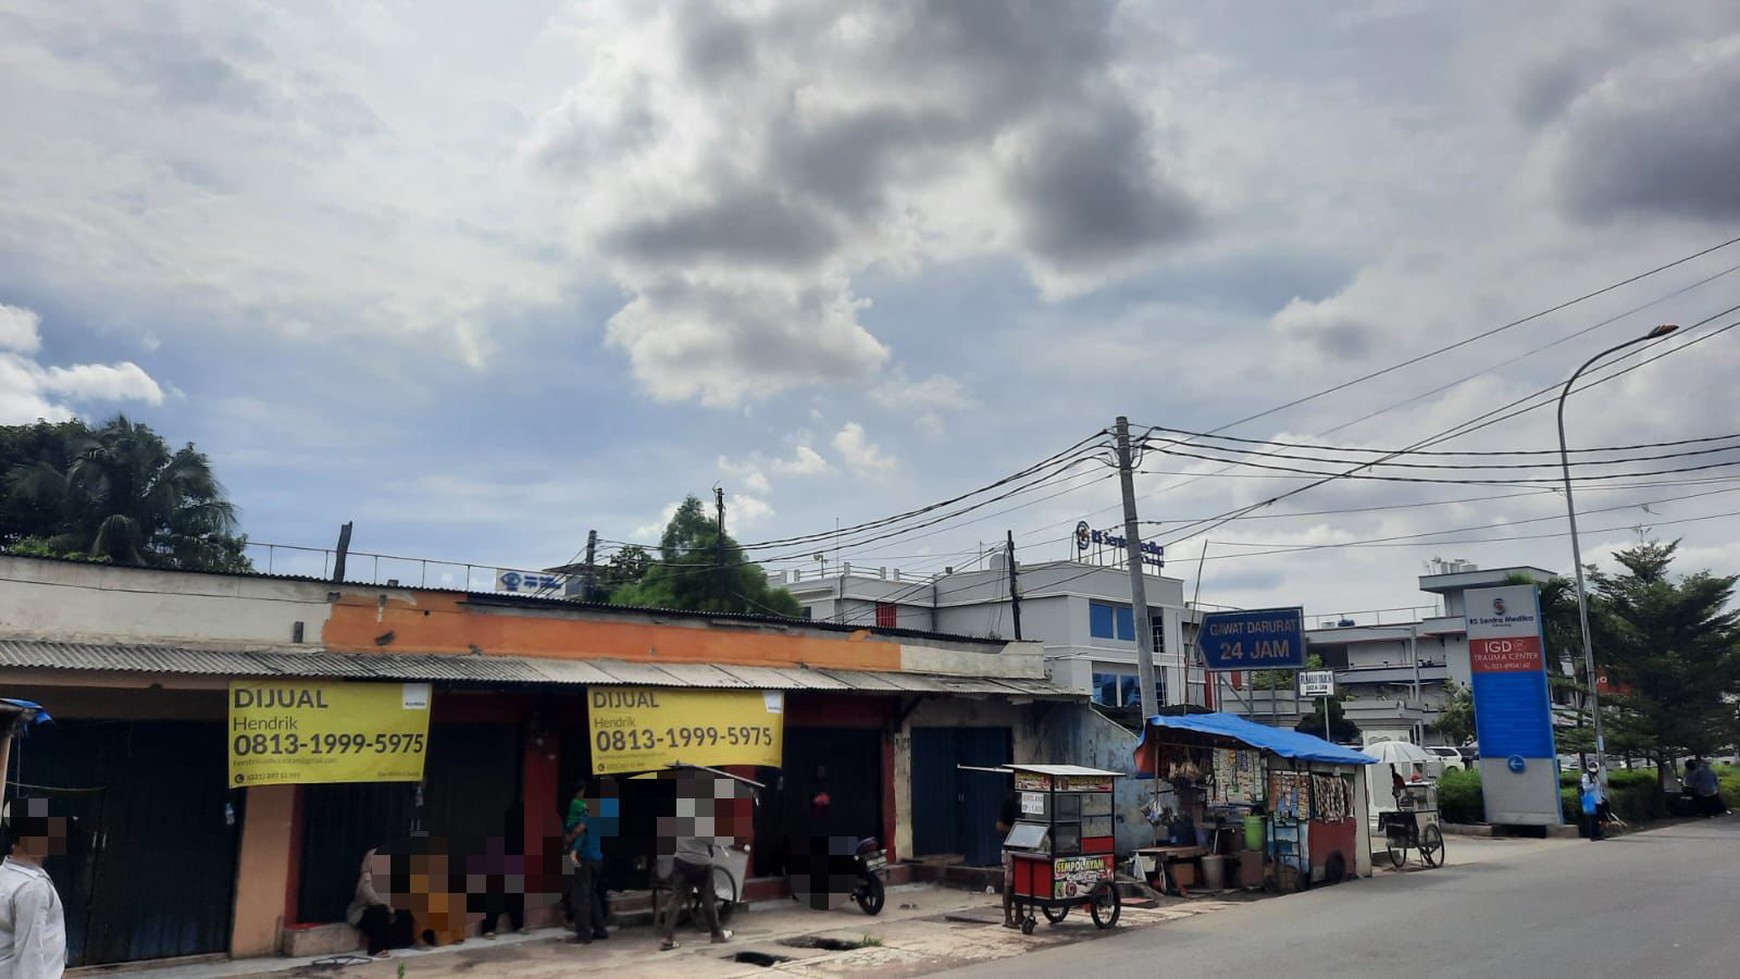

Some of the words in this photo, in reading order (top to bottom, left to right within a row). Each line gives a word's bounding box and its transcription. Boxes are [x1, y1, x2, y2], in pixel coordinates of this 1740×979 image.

[1210, 621, 1244, 636] GAWAT
[1247, 618, 1297, 634] DARURAT
[1480, 617, 1503, 625] Sentra
[1220, 641, 1243, 660] 24
[1250, 639, 1290, 659] JAM
[1484, 641, 1512, 653] IGD
[1473, 654, 1507, 662] TRAUMA
[1508, 652, 1538, 660] CENTER
[234, 688, 328, 709] DIJUAL
[593, 691, 659, 709] DIJUAL
[233, 716, 298, 731] Hendrik
[594, 717, 636, 728] Hendrik
[234, 733, 424, 756] 0813-1999-5975
[596, 726, 772, 752] 0813-1999-5975
[1056, 859, 1085, 872] SEMPOL
[1086, 858, 1104, 870] AYAM
